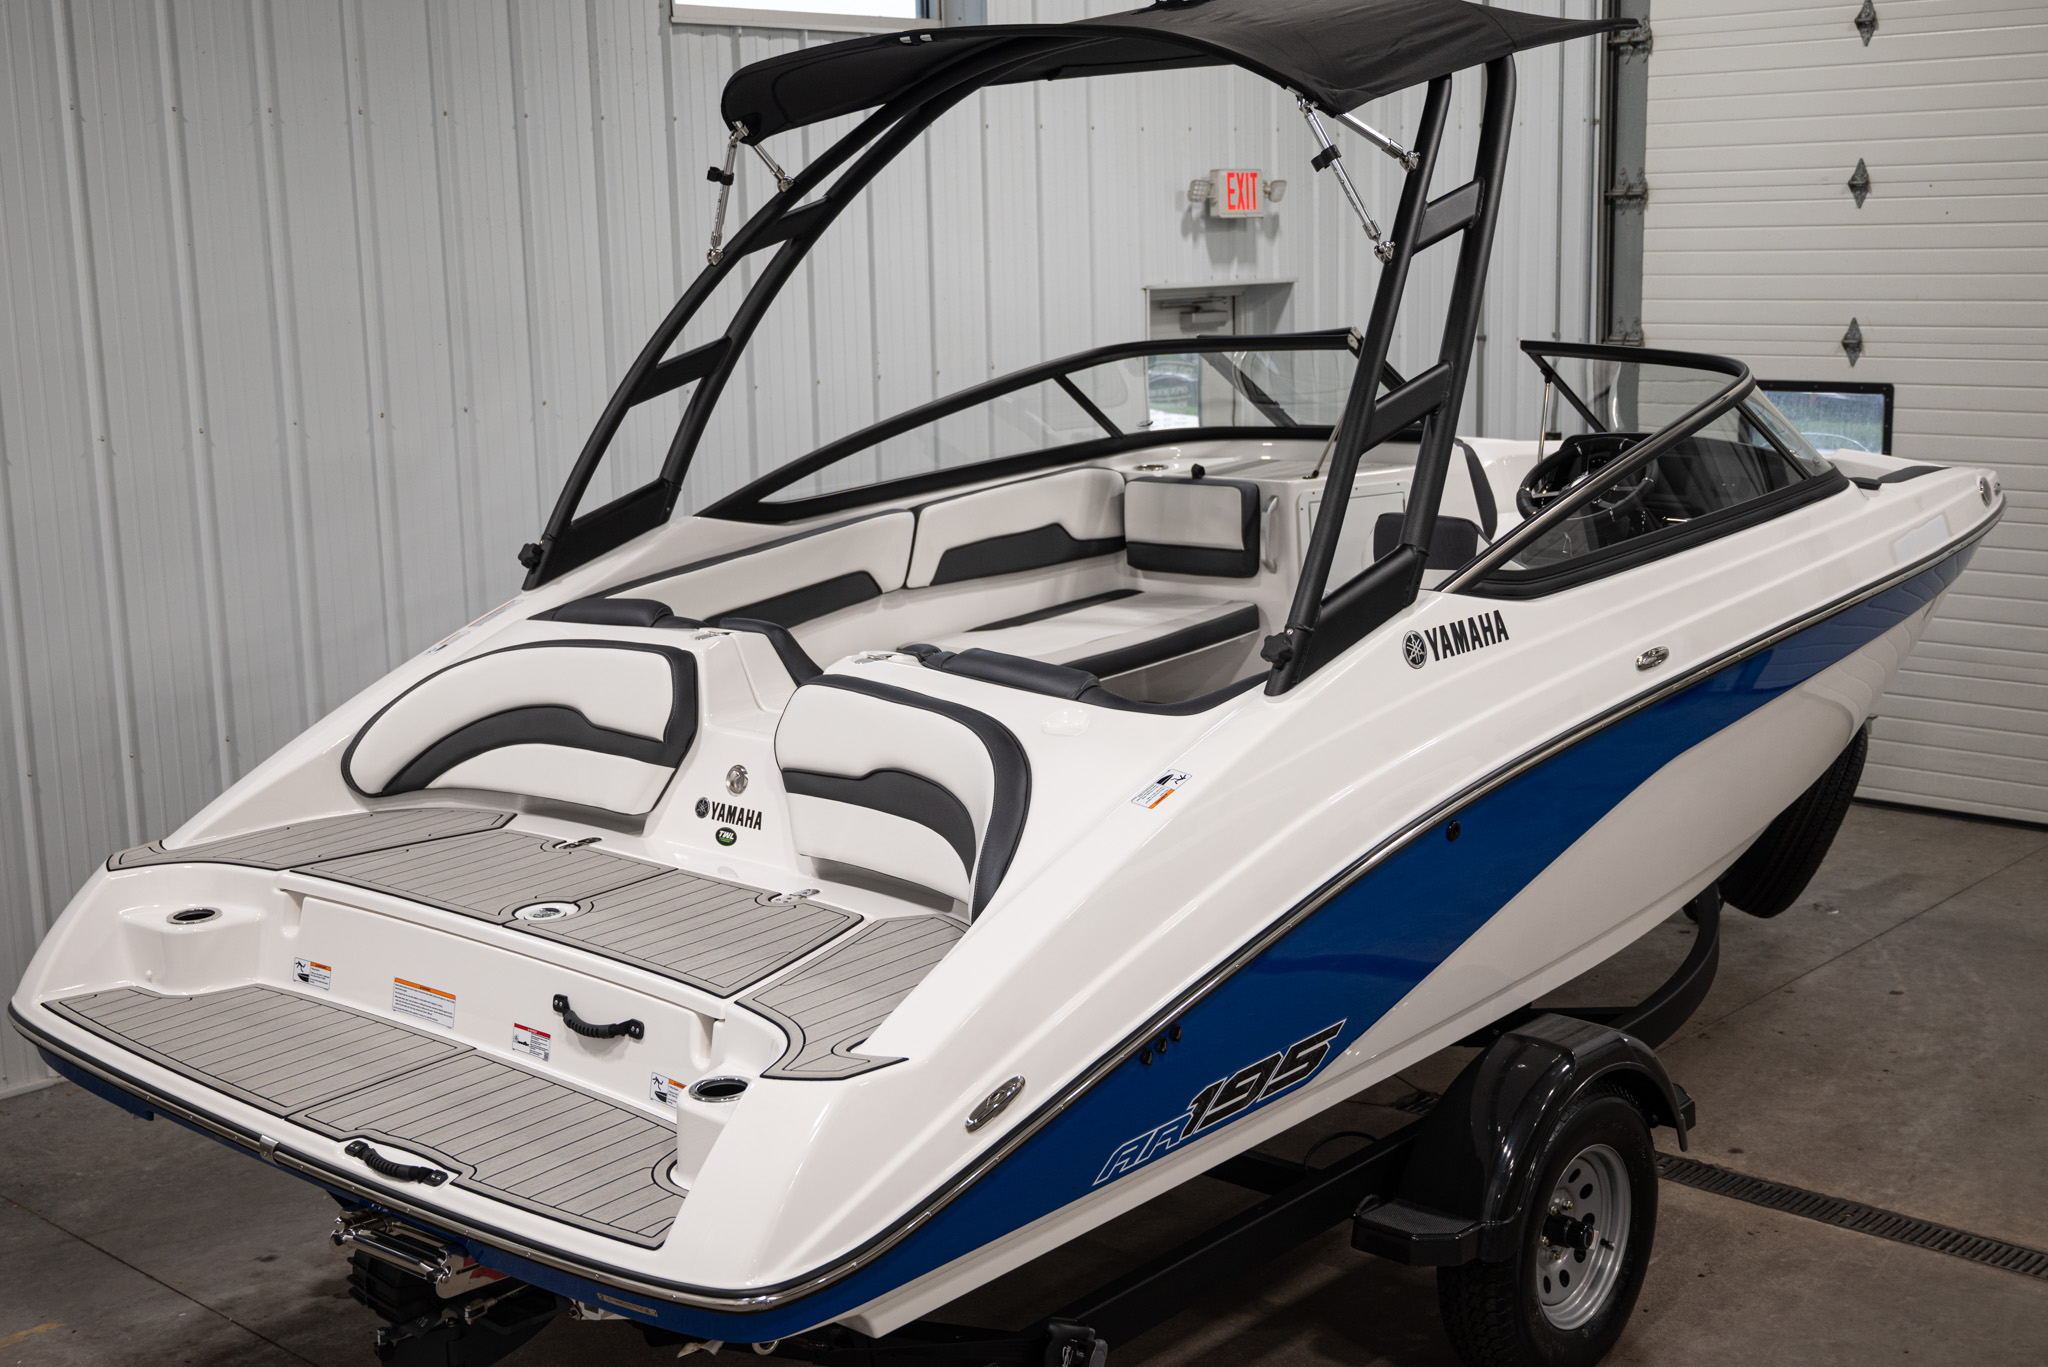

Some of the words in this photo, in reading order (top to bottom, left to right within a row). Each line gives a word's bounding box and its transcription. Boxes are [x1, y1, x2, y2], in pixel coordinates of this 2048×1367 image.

[1227, 172, 1258, 210] EXIT
[1424, 609, 1509, 662] YAMAHA
[711, 801, 762, 831] YAMAHA
